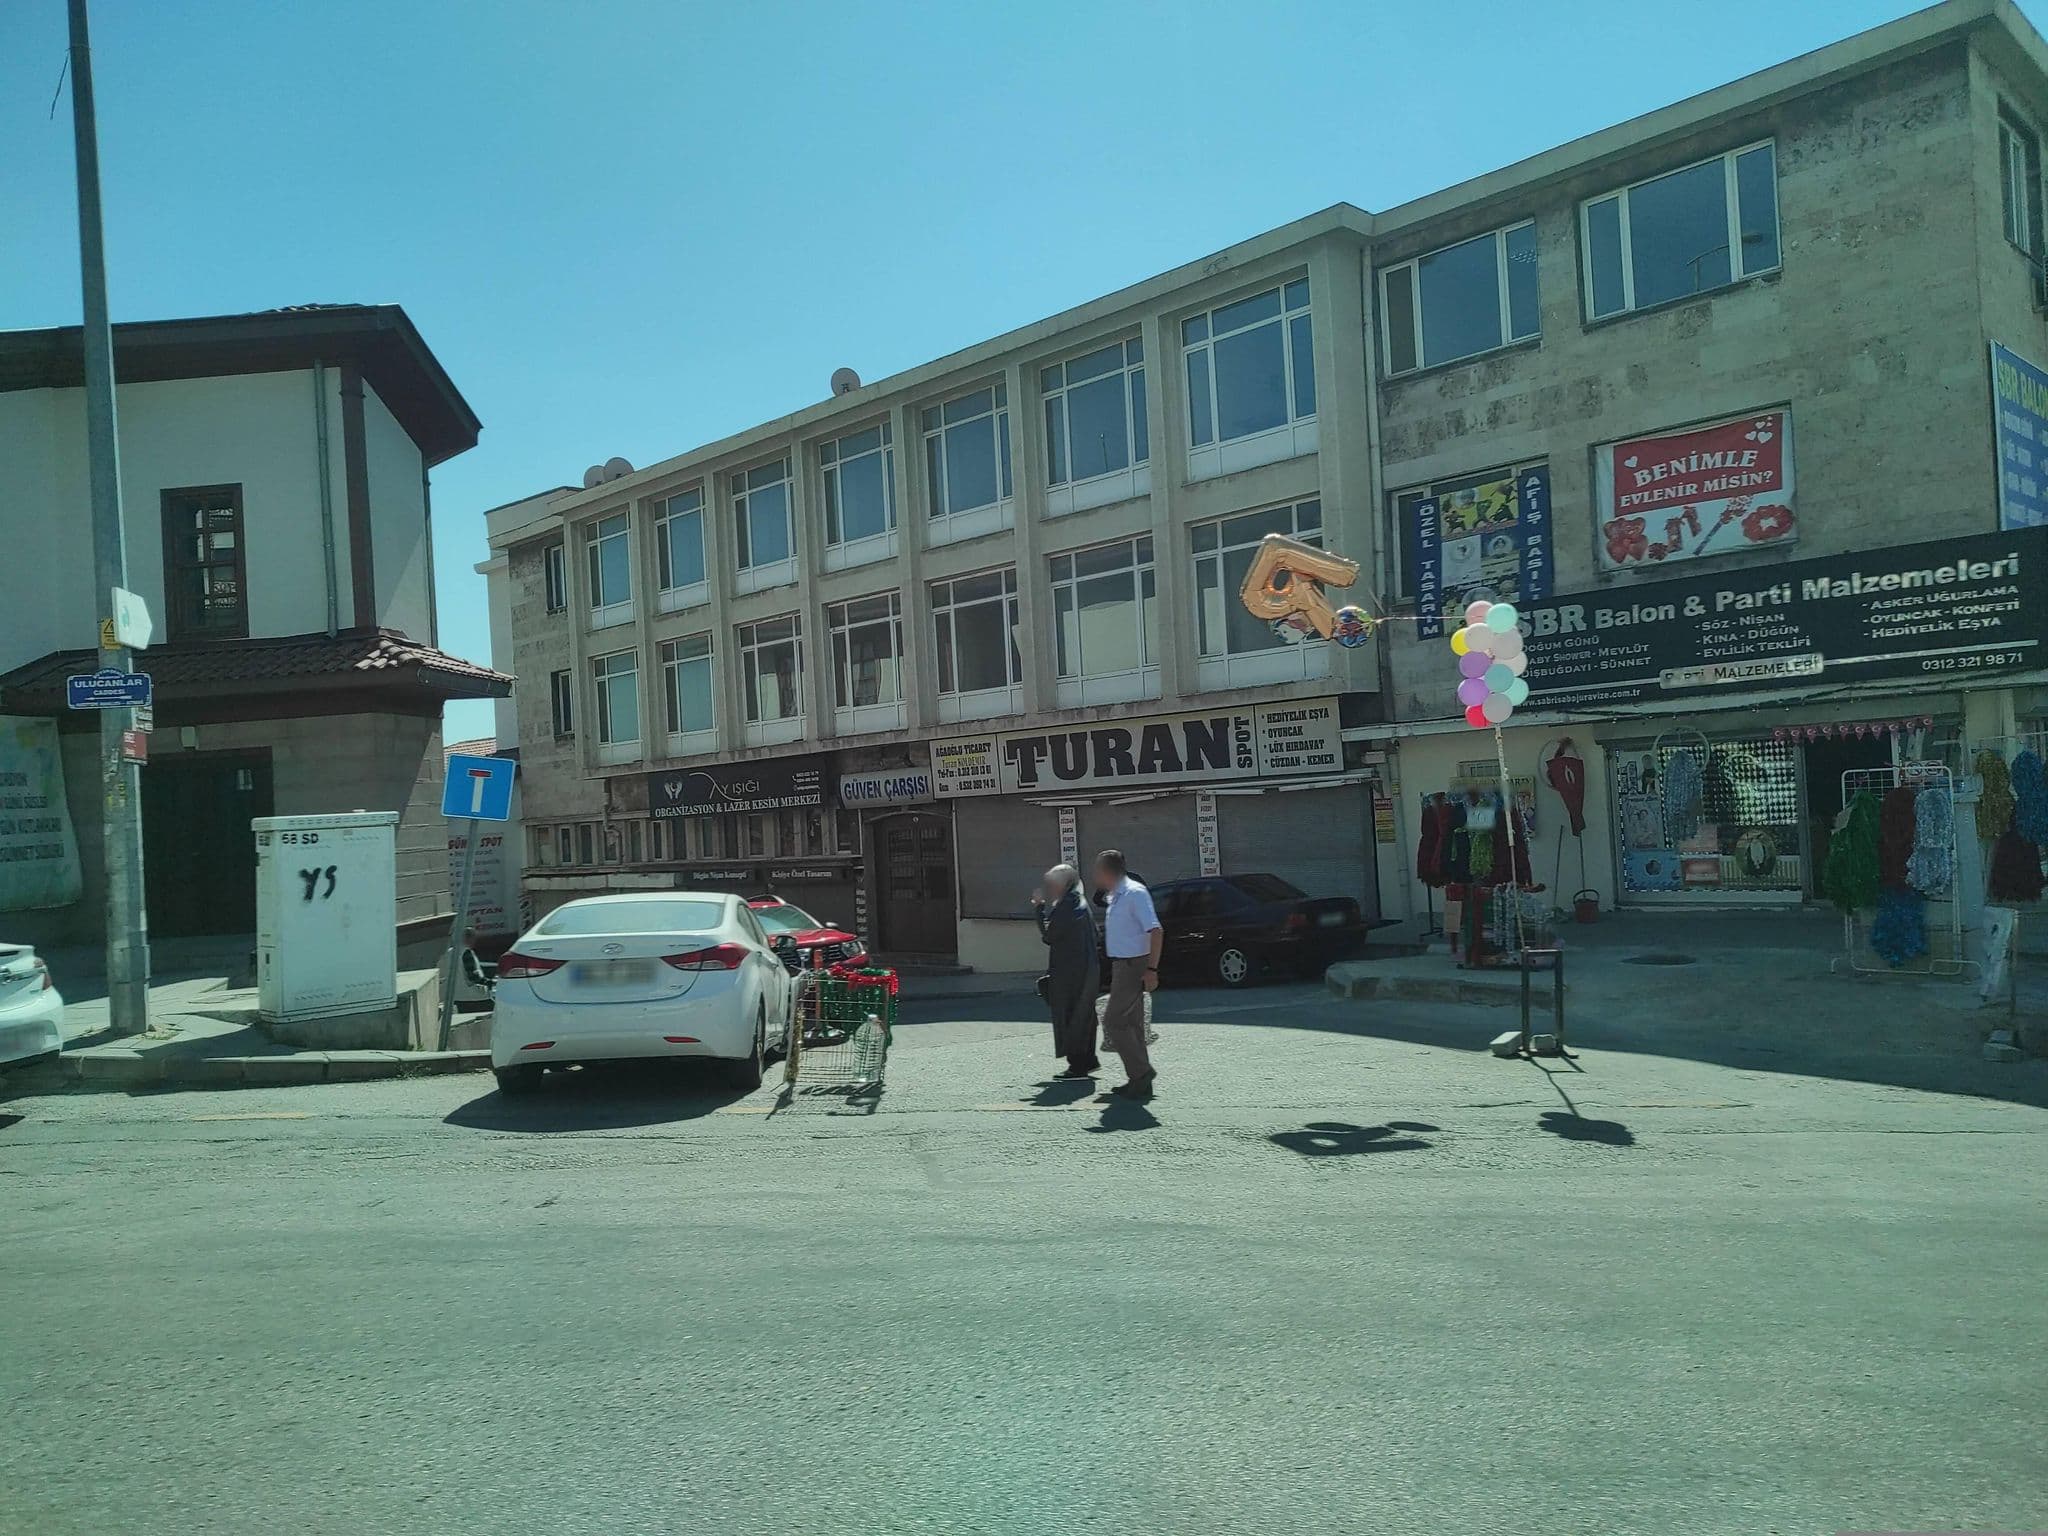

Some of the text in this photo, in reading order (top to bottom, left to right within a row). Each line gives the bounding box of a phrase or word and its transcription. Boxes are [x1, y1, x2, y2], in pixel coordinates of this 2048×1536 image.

[1633, 450, 1758, 487] BENİMLE
[1620, 470, 1773, 507] EVLENİR MİSİN?
[1525, 476, 1543, 524] AFİŞ
[1419, 504, 1439, 635] ÖZEL TASARIM
[1517, 553, 2019, 639] SBR Balon & Parti Malzemeleri
[1870, 585, 2019, 610] ASKER UĞURLAMA
[1702, 613, 1785, 631] SÖZ NİŞAN
[1870, 598, 2020, 624] OYUNCAK KONFETİ
[1702, 625, 1799, 645] KINA DÜĞÜN
[1872, 617, 2001, 639] HEDİYELİK EŞYA
[1521, 635, 1600, 653] DOĞUM GÜNÜ
[1528, 655, 1551, 665] ABY
[1599, 643, 1649, 657] MEVLÜT
[1703, 635, 1811, 659] EVLİLİK TEKLİFİ
[1600, 656, 1651, 670] SÜNNET
[1922, 652, 2023, 670] 0312 321 98 71
[74, 679, 143, 688] ULUCANLAR
[1308, 707, 1329, 721] EŞYA
[1268, 725, 1303, 738] OYUNCAK
[1003, 716, 1253, 788] TURAN SPOT
[1270, 754, 1335, 768] CÜZDAN KEMER
[733, 779, 760, 795] IŞIĞI
[844, 779, 882, 800] GÜVEN
[884, 775, 929, 801] ÇARŞISI
[655, 803, 715, 818] ORGANİZASYON
[724, 800, 751, 813] LAZER
[752, 796, 779, 810] KESİM
[781, 792, 821, 808] MERKEZİ
[301, 833, 319, 845] SD
[480, 836, 503, 847] SPOT
